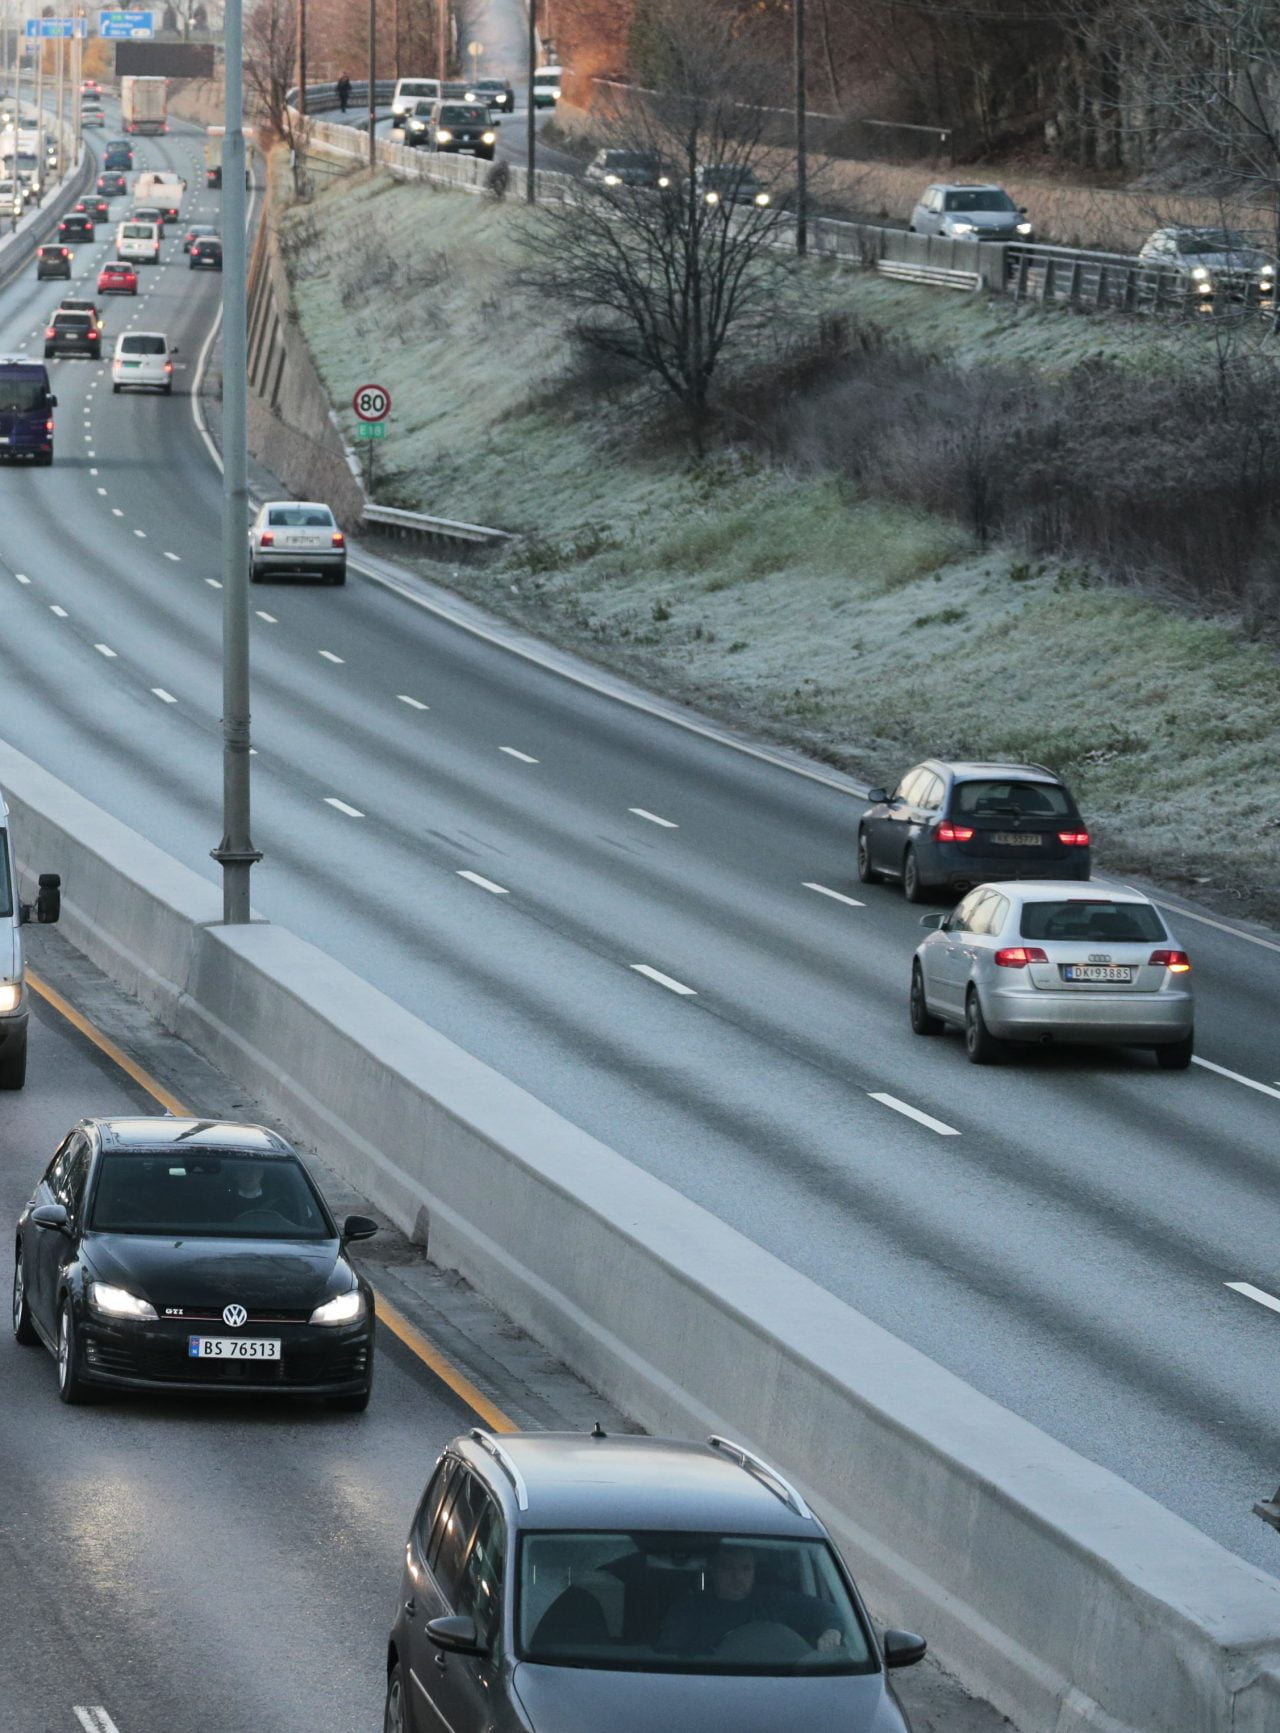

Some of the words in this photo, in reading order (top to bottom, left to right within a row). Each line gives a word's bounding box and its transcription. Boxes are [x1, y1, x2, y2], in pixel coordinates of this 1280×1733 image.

[360, 394, 385, 412] 80
[1075, 967, 1090, 977] DK
[1095, 968, 1129, 979] 93885
[204, 1341, 223, 1355] BS
[230, 1342, 275, 1357] 76513
